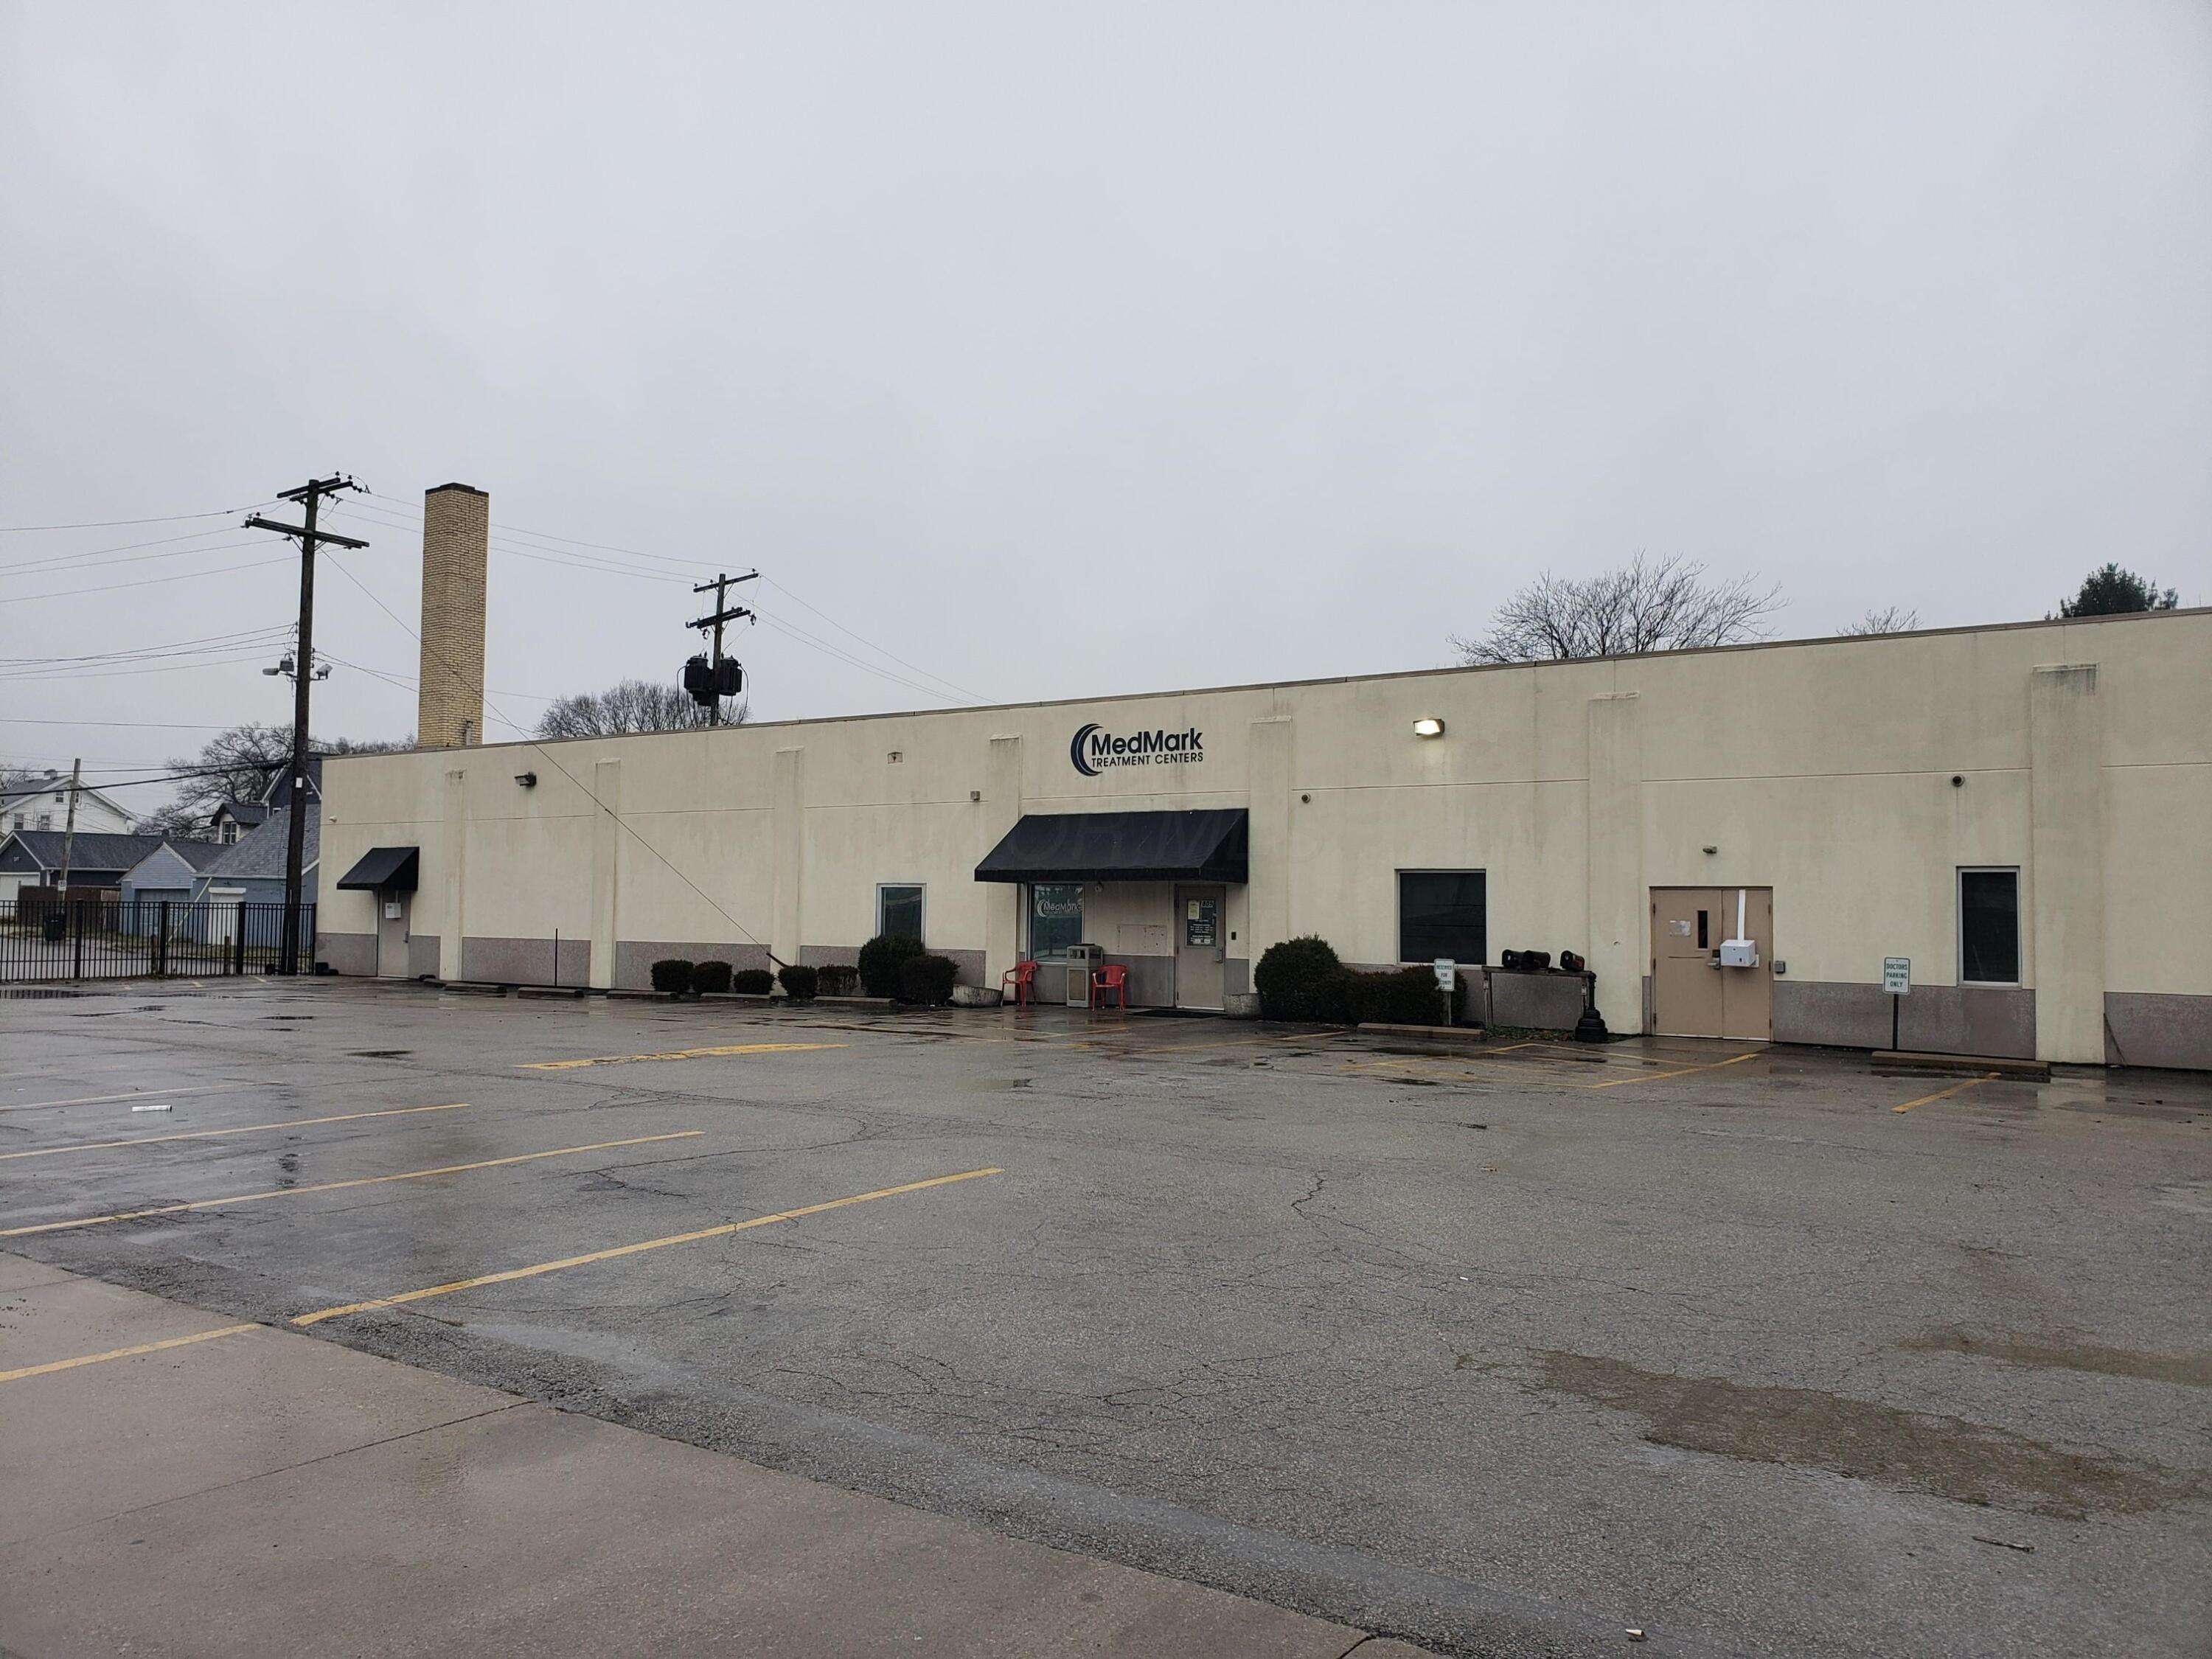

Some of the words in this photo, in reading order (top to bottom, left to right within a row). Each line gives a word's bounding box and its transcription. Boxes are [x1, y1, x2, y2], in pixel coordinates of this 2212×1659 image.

[1092, 728, 1203, 756] MedMark
[1092, 755, 1151, 768] TREATMENT
[1155, 752, 1203, 764] CENTERS
